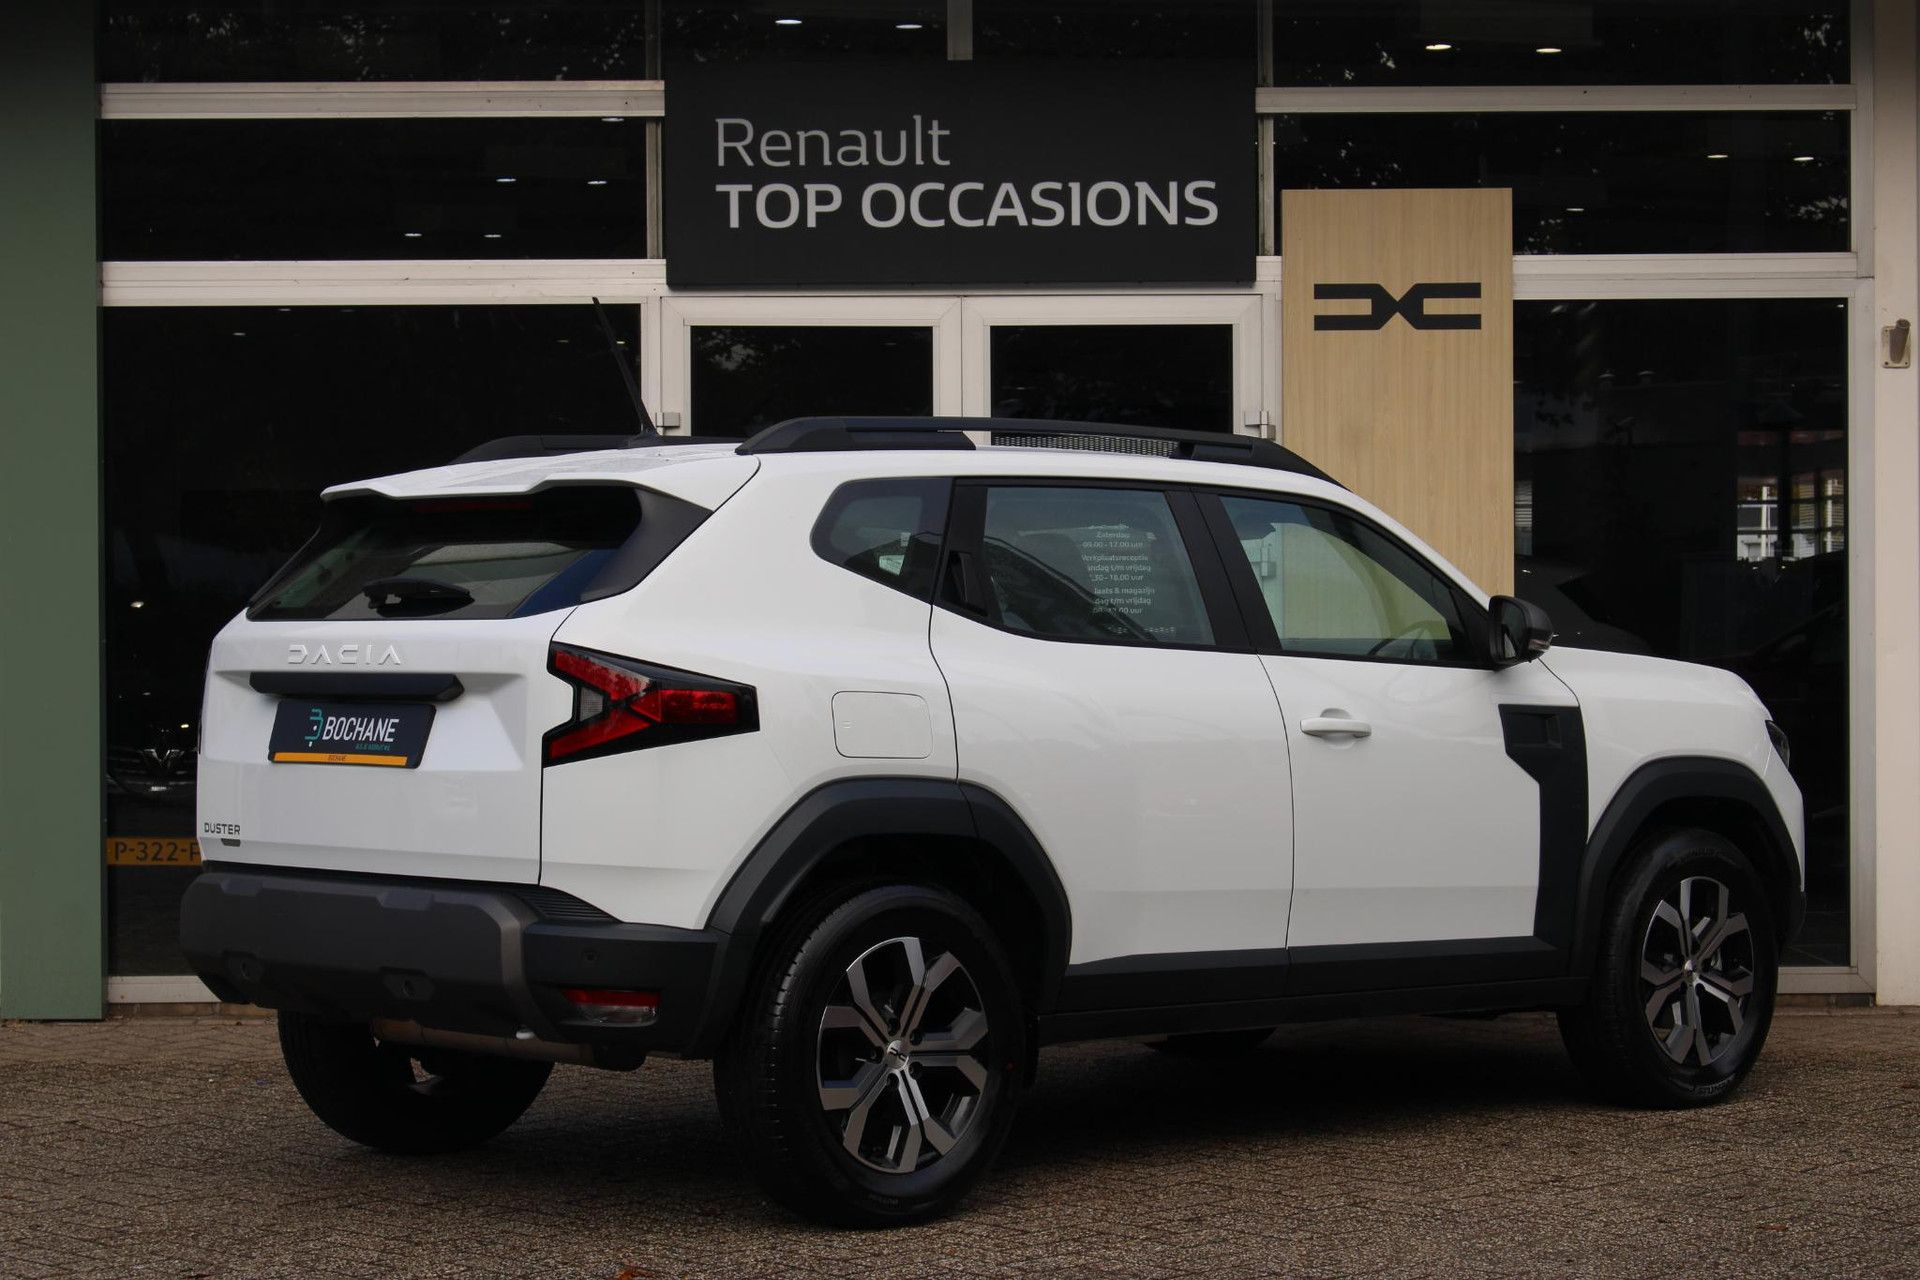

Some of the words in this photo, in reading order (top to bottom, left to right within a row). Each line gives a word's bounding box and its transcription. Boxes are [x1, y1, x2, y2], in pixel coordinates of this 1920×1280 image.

[715, 114, 951, 167] Renault
[715, 183, 843, 228] TOP
[861, 180, 1219, 228] OCCASIONS
[288, 644, 401, 666] DACIA
[322, 716, 400, 743] BOCHANE
[203, 822, 241, 836] DUSTER
